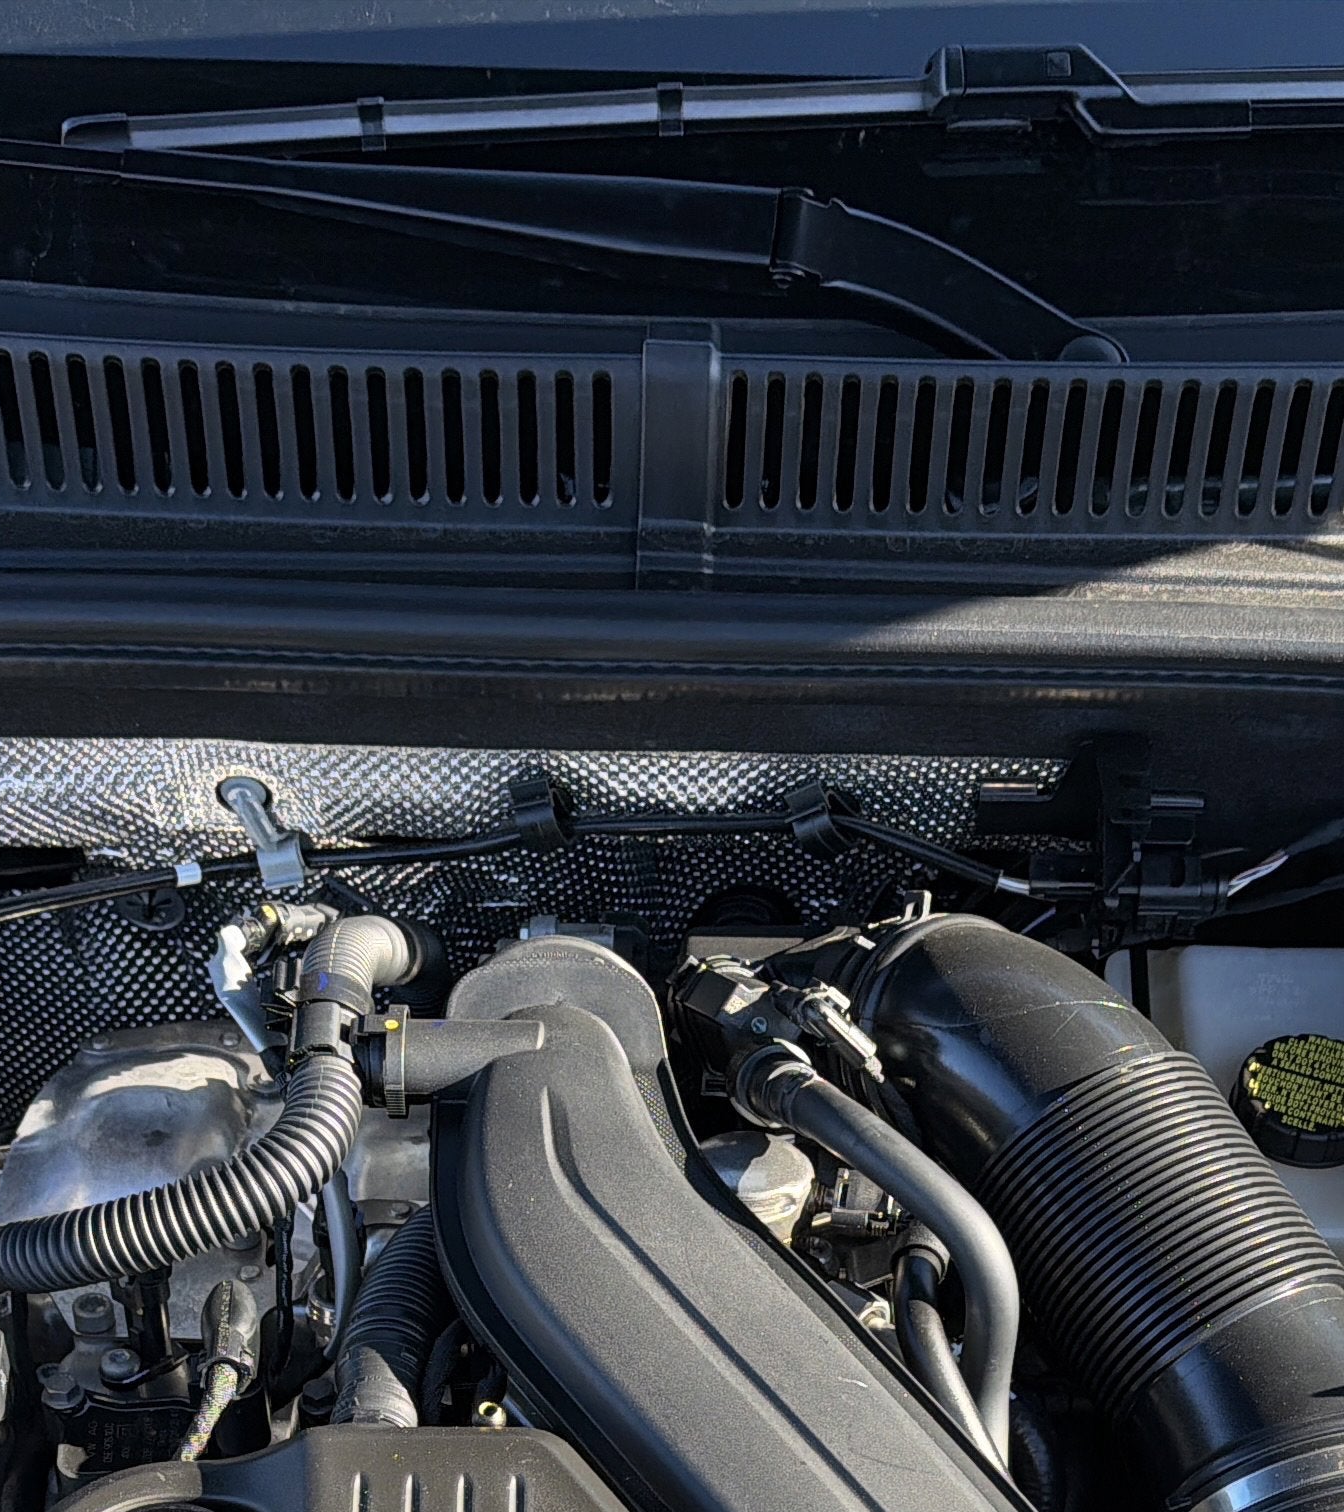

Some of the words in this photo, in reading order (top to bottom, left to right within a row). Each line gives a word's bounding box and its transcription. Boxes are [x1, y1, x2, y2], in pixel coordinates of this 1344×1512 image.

[1270, 1049, 1294, 1062] ONLY
[1295, 1056, 1313, 1067] DOT
[1278, 1060, 1312, 1075] SEALED
